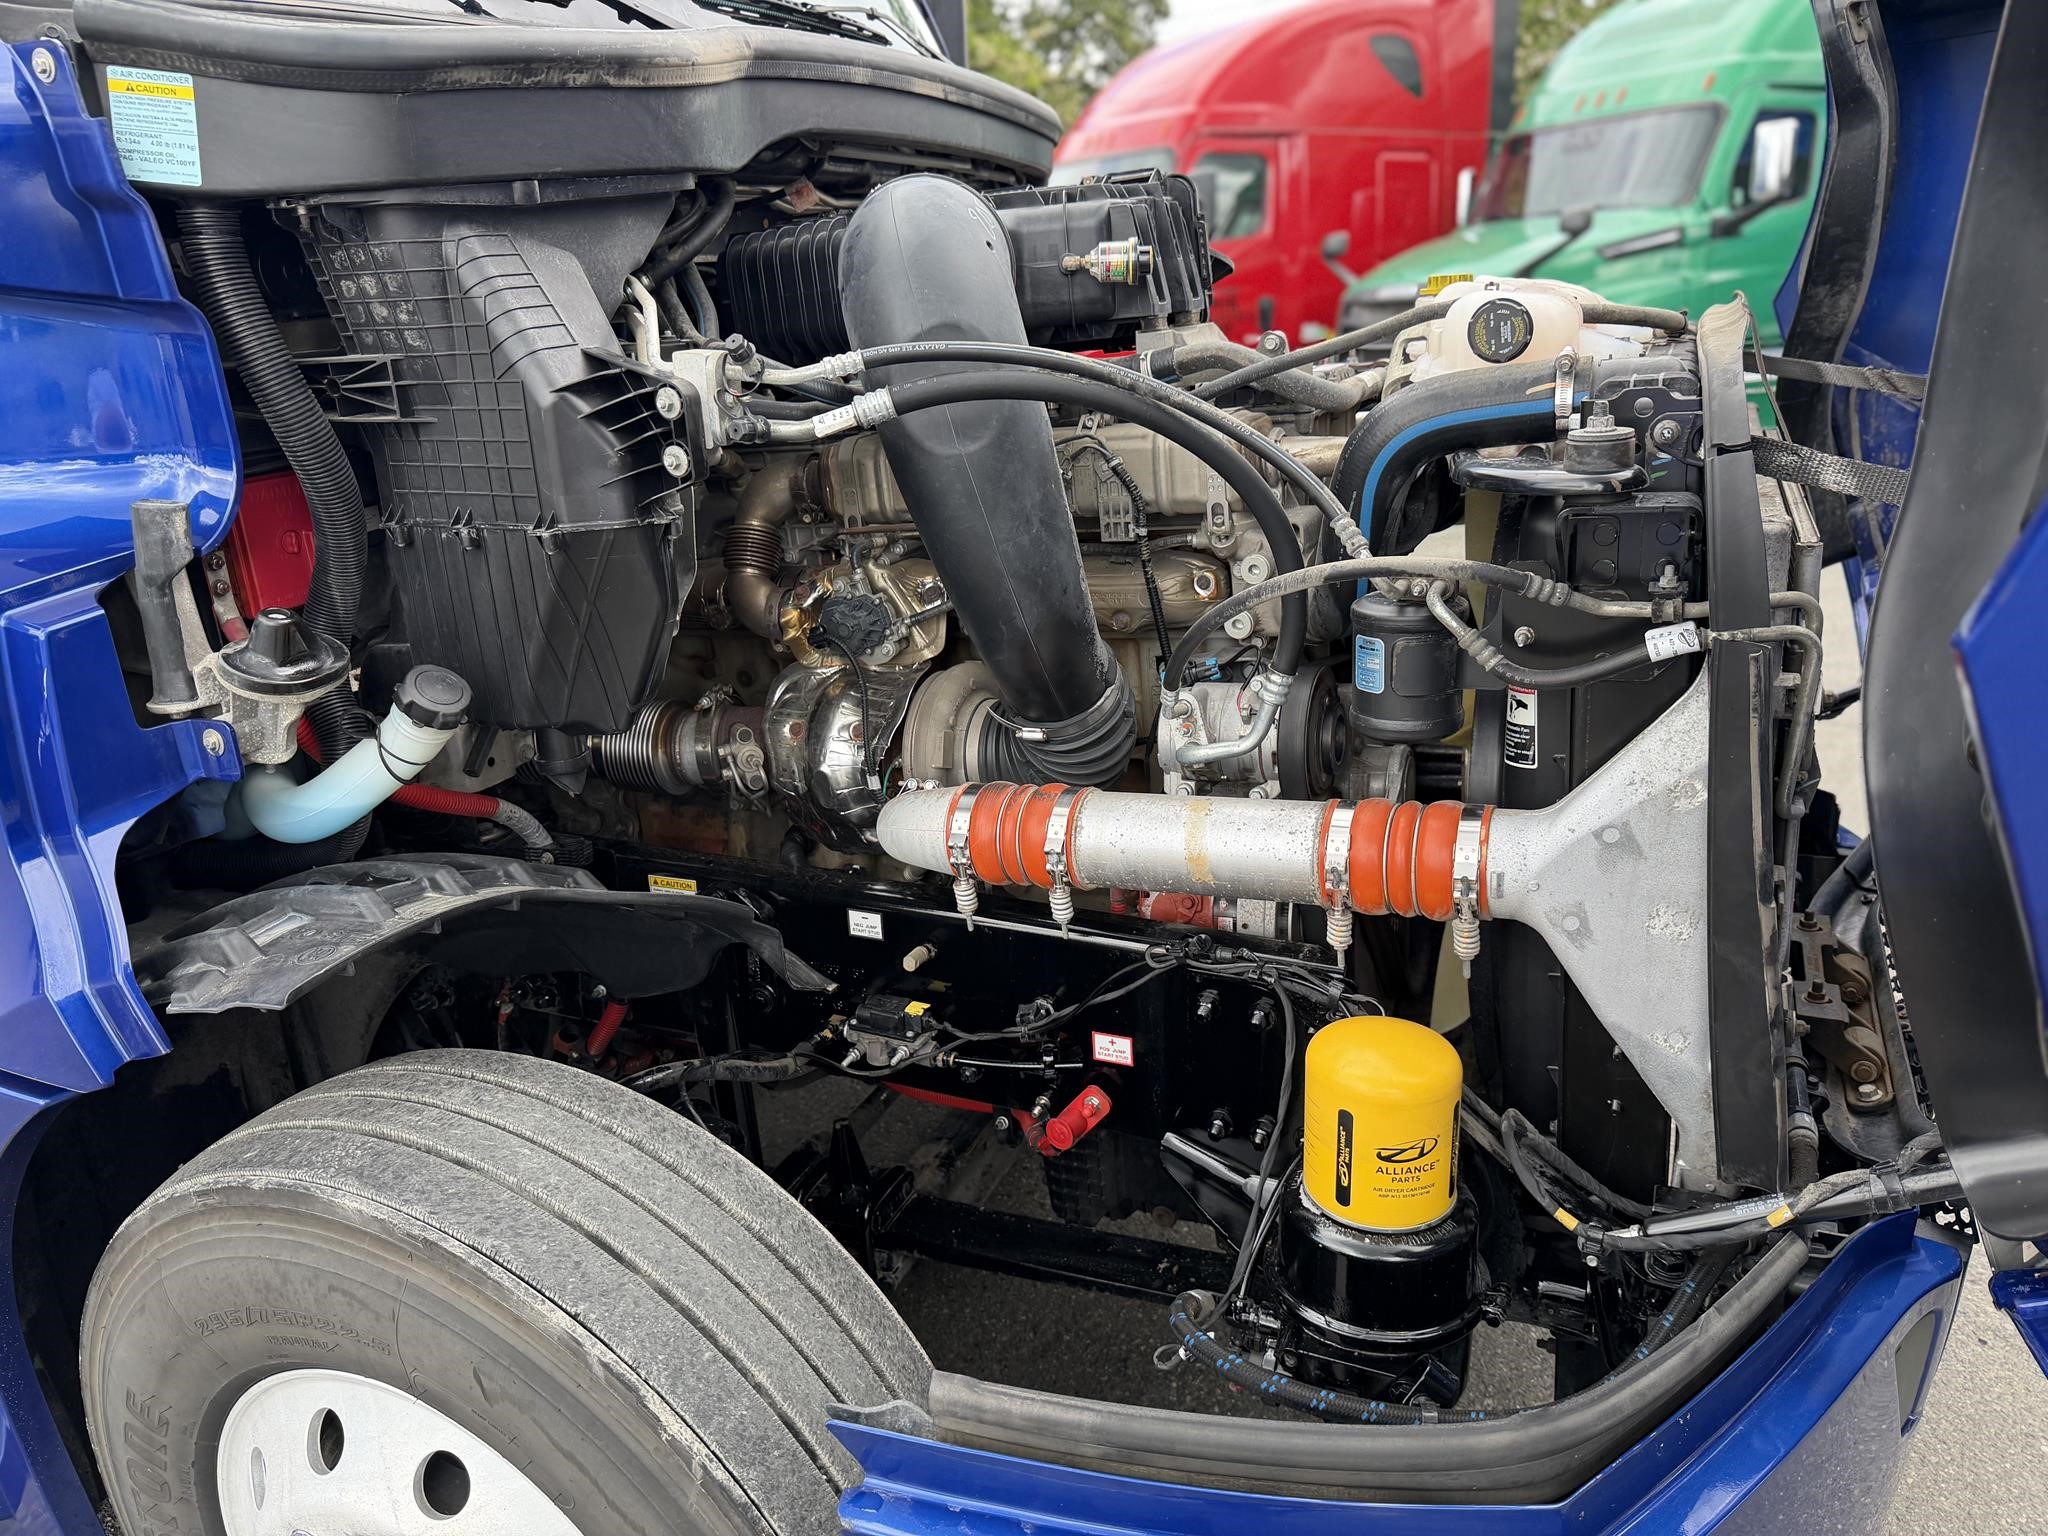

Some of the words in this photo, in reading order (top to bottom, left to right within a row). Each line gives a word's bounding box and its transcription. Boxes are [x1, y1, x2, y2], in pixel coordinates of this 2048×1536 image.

[119, 69, 133, 78] AIR
[135, 71, 190, 84] CONDITIONER
[135, 84, 177, 96] CAUTION
[116, 136, 141, 145] R-134a
[118, 147, 164, 157] COMPRESSOR
[139, 155, 164, 164] VALEO
[166, 158, 196, 167] VC100YF
[914, 343, 946, 351] GALAXY
[660, 880, 693, 890] CAUTION
[1339, 1130, 1347, 1162] ALLIANCE
[1376, 1162, 1436, 1176] ALLIANCE
[1391, 1175, 1421, 1183] PARTS
[1405, 1182, 1436, 1193] CARTRIDGE
[193, 1305, 392, 1357] 295/75R22.5
